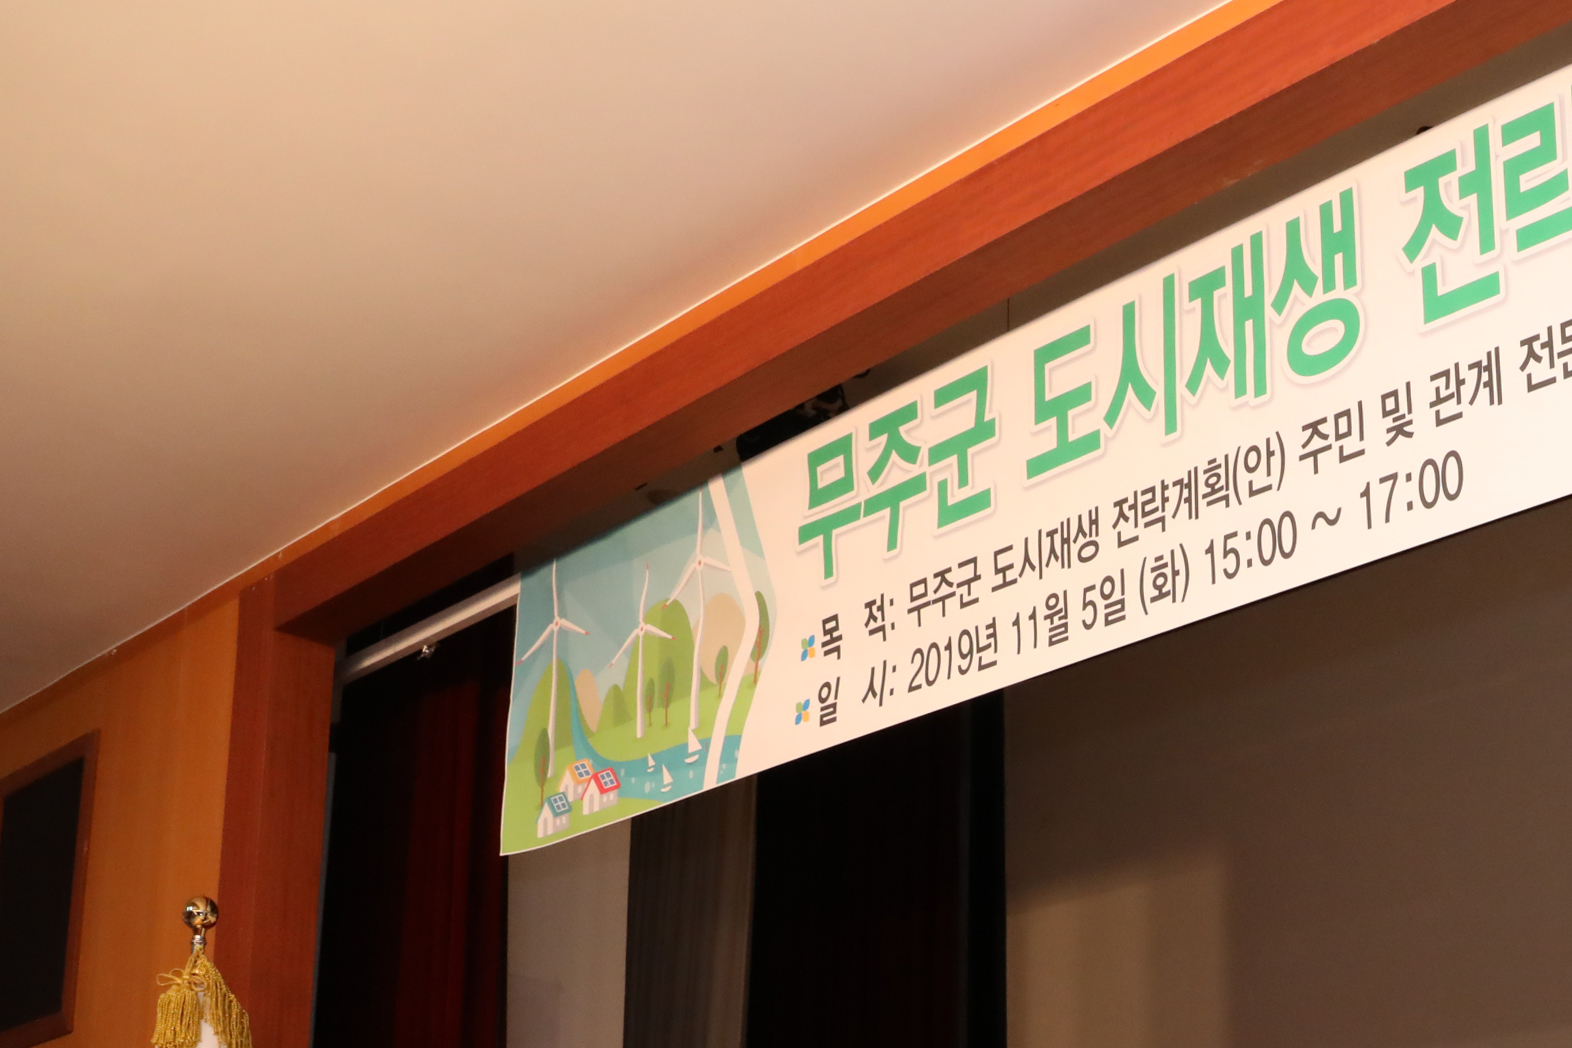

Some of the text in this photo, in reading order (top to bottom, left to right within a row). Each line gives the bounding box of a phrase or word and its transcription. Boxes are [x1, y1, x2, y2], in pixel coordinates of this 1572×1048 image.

[799, 367, 994, 578] 무주군
[1026, 188, 1360, 478] 도시재생
[819, 613, 843, 661] 목
[907, 556, 982, 627] 무주군
[991, 506, 1100, 592] 도시재생
[1112, 431, 1286, 549] 전략계획(안)
[1299, 401, 1366, 475] 주민
[1381, 381, 1414, 446] 및
[1429, 347, 1503, 427] 관계
[817, 677, 841, 727] 일
[908, 630, 998, 694] 2019년
[1012, 590, 1069, 655] 11월
[1081, 568, 1127, 630] 5일
[1139, 543, 1190, 616] (화)
[1205, 510, 1298, 585] 15:00
[1359, 450, 1464, 530] 17:00
